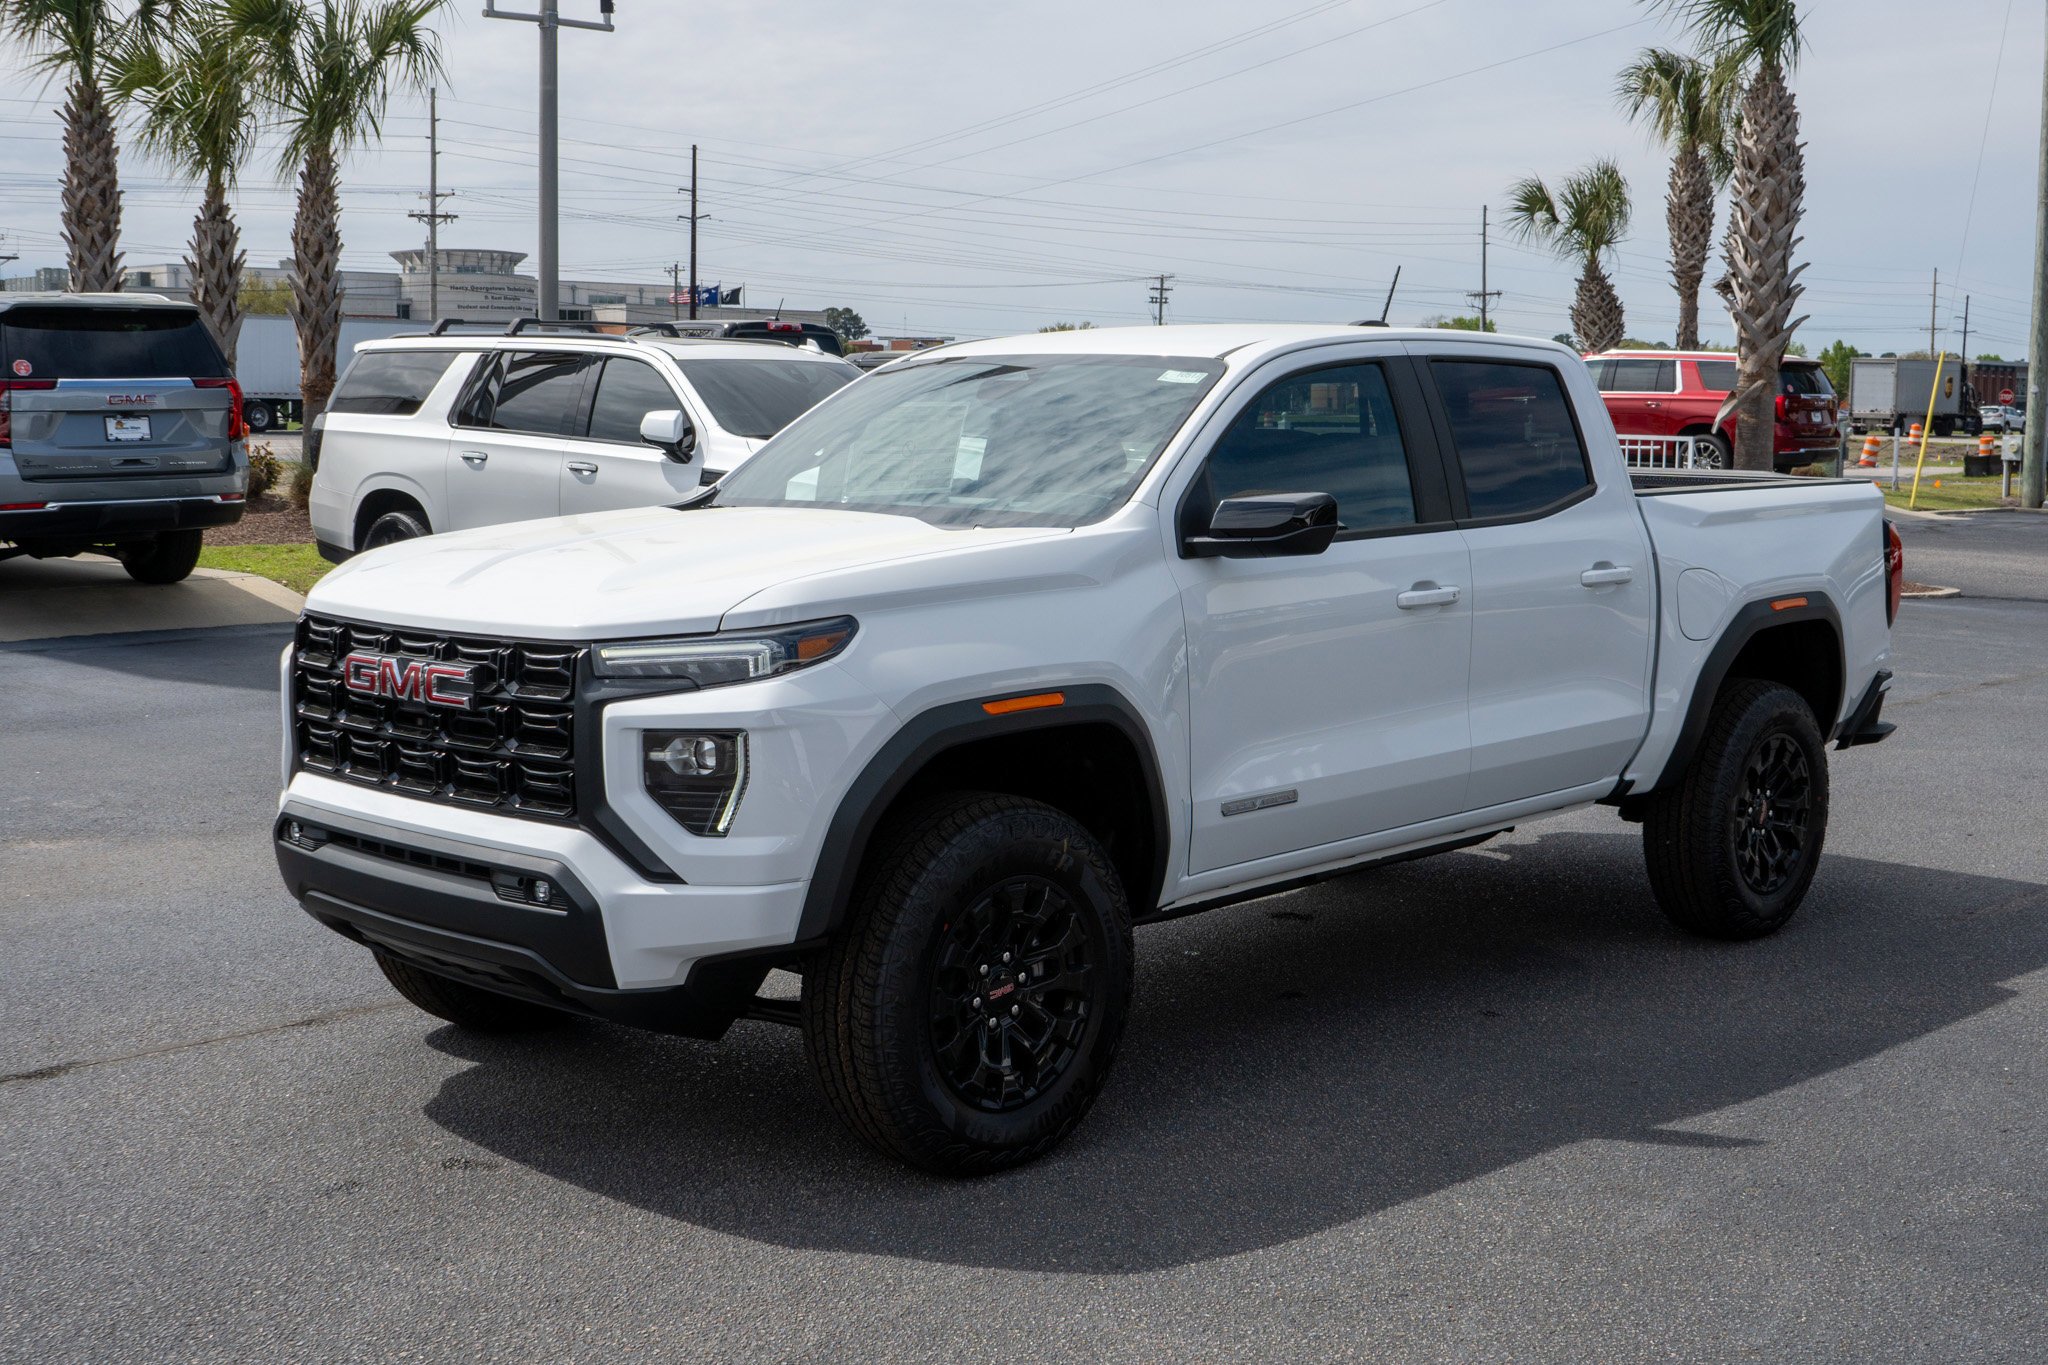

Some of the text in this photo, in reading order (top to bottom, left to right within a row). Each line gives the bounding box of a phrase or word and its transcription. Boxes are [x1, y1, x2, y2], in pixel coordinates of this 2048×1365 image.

[107, 394, 157, 405] GMC
[1999, 393, 2013, 401] STOP
[344, 651, 472, 710] GMC
